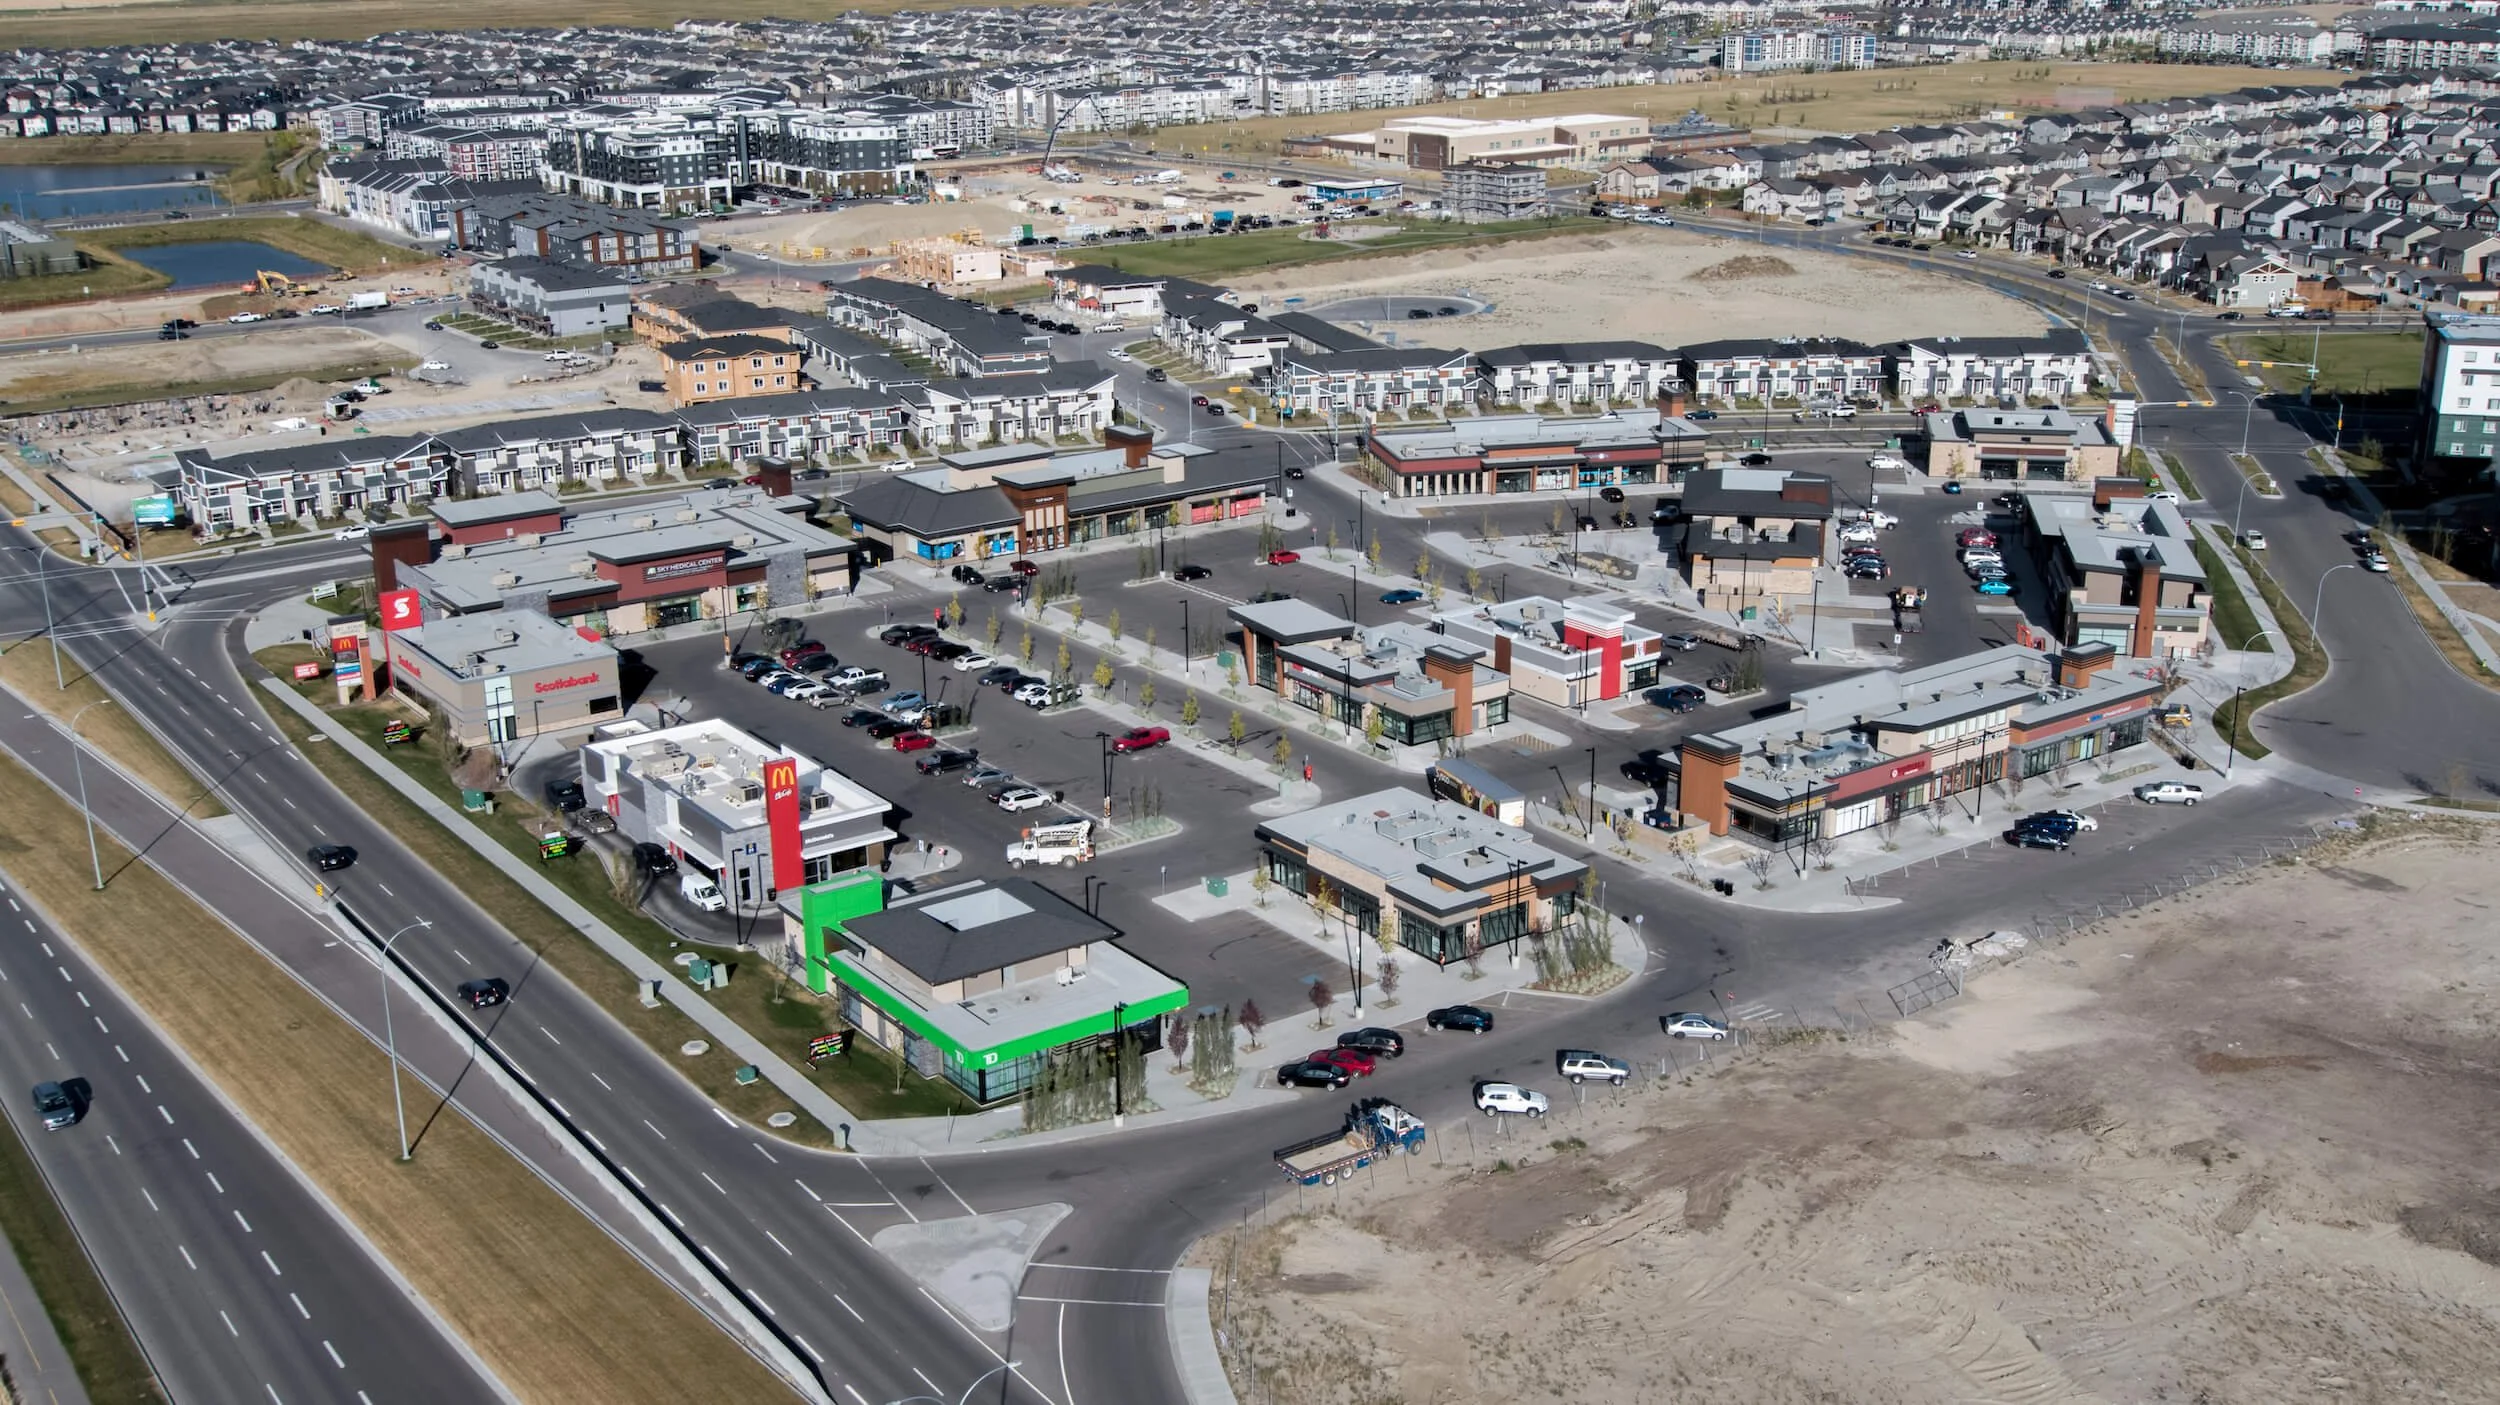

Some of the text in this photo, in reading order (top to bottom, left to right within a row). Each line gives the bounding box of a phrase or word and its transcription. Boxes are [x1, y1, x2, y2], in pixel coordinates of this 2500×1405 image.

[656, 565, 671, 573] SKY
[670, 561, 697, 571] MEDICAL
[697, 556, 723, 566] CENTER
[534, 672, 599, 693] Scotiabank
[983, 1052, 998, 1065] TD
